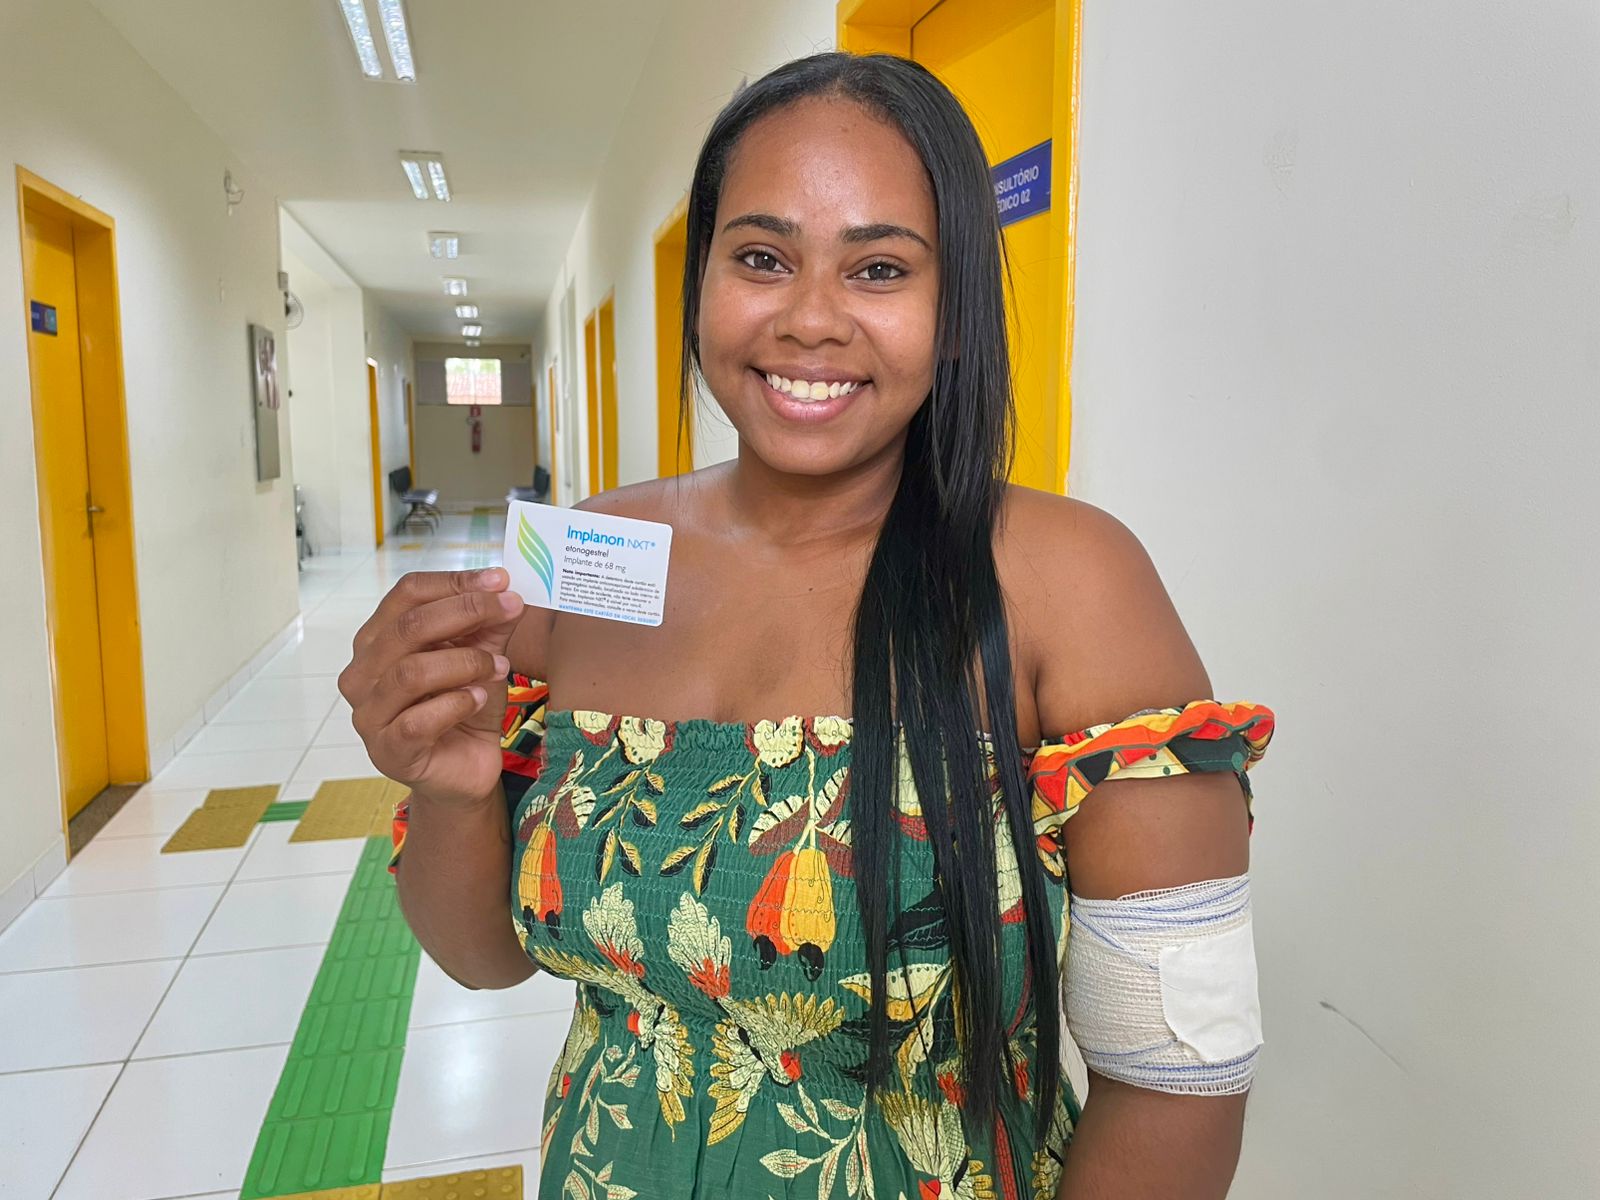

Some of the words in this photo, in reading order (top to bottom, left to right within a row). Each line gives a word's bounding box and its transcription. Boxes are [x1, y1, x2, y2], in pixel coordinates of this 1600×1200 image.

[997, 194, 1020, 214] ÉDICO
[567, 525, 625, 547] Implanon
[565, 545, 610, 558] etonogestrel
[563, 556, 593, 567] Implante
[594, 559, 603, 569] de
[604, 562, 614, 570] 68
[615, 565, 627, 574] mg
